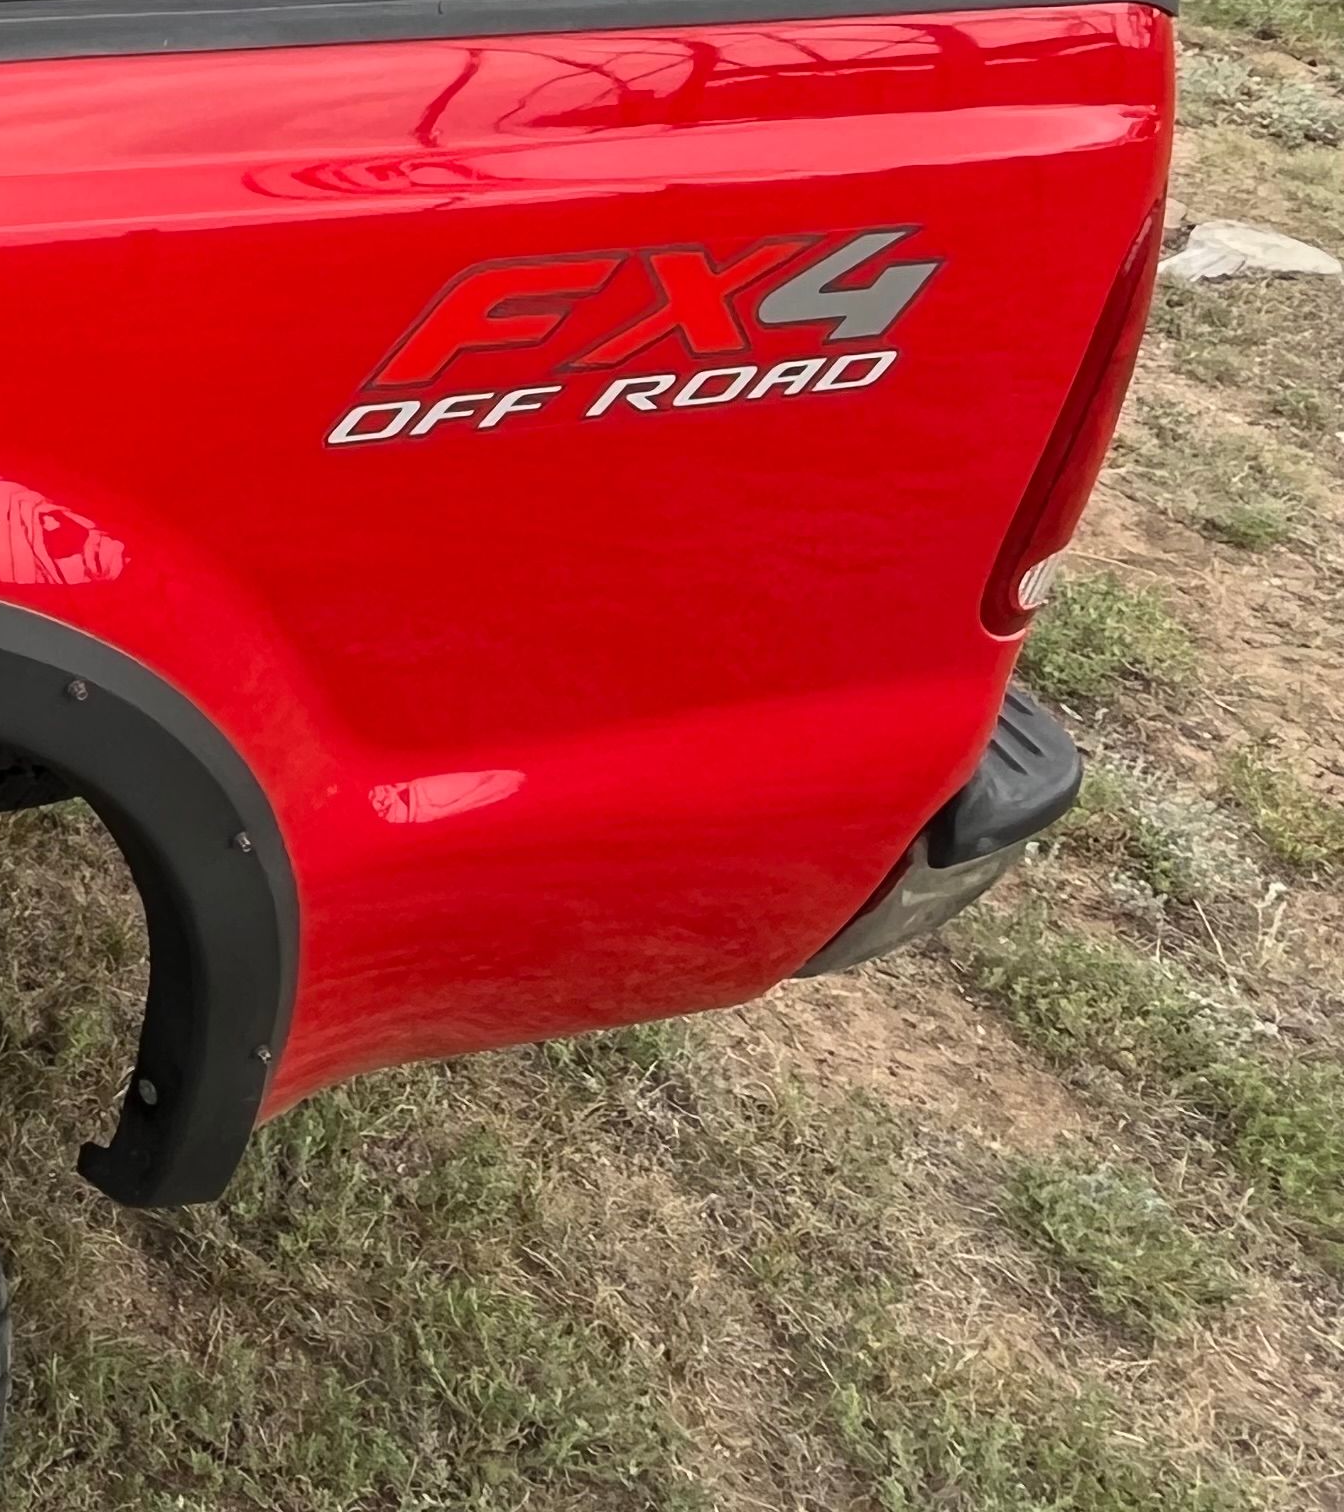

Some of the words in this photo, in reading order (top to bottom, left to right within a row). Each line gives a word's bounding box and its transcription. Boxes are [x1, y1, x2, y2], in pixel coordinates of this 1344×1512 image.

[362, 225, 944, 390] FX4
[325, 384, 564, 445] OFF
[585, 349, 899, 418] ROAD
